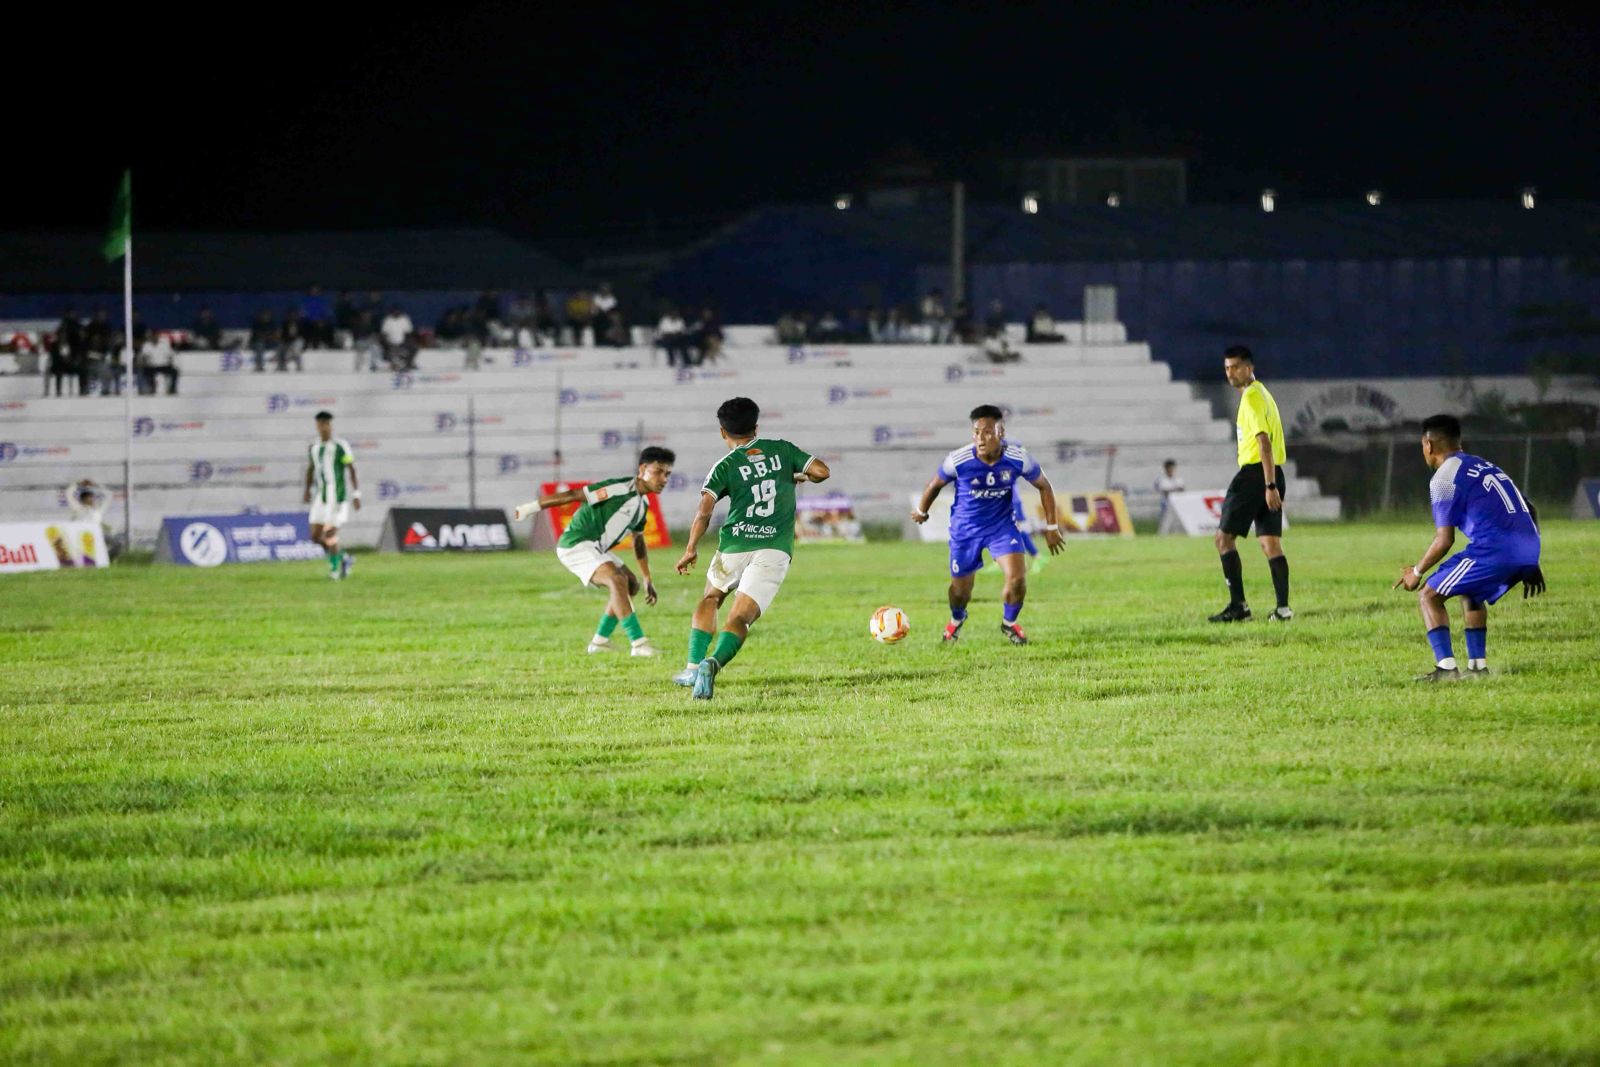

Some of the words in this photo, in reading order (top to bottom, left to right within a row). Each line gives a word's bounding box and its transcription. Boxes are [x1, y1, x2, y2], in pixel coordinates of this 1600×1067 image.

[738, 454, 782, 481] P.B.U
[986, 471, 996, 486] 6
[746, 479, 777, 517] 19
[1482, 473, 1529, 514] 17
[745, 523, 759, 533] NIC
[758, 525, 777, 534] ASIA
[952, 559, 960, 573] 6
